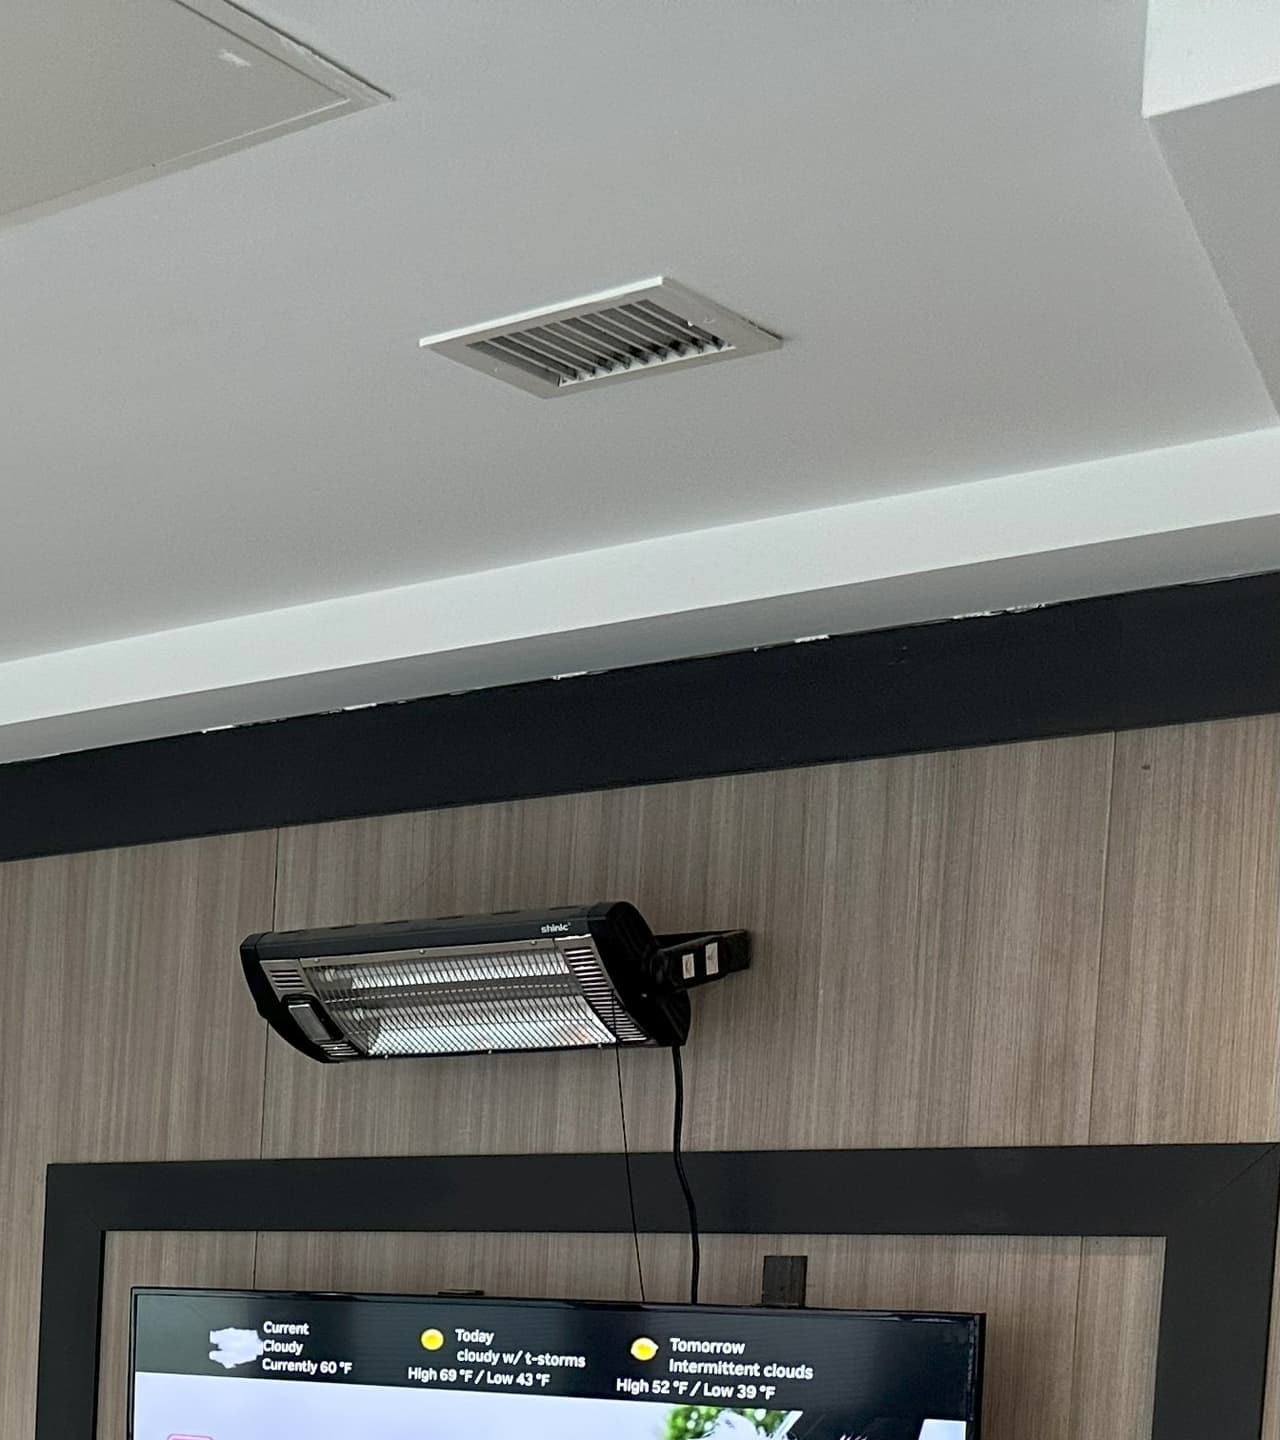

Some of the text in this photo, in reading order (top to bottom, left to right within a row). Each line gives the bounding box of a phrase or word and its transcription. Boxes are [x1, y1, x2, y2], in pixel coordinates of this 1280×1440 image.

[263, 1321, 310, 1336] Current
[455, 1328, 494, 1346] Today
[262, 1339, 304, 1356] Cloudy
[669, 1338, 746, 1356] Tomorrow
[262, 1357, 318, 1375] Currently
[320, 1360, 337, 1374] 60
[456, 1347, 586, 1369] cloudy w/ t-storms
[407, 1366, 438, 1383] High
[439, 1368, 458, 1382] 69
[487, 1370, 514, 1385] Low
[516, 1372, 534, 1386] 43
[669, 1358, 814, 1380] Intermittent clouds
[616, 1377, 650, 1396] High
[652, 1379, 671, 1394] 52
[703, 1382, 735, 1399] Low
[737, 1384, 758, 1400] 39
